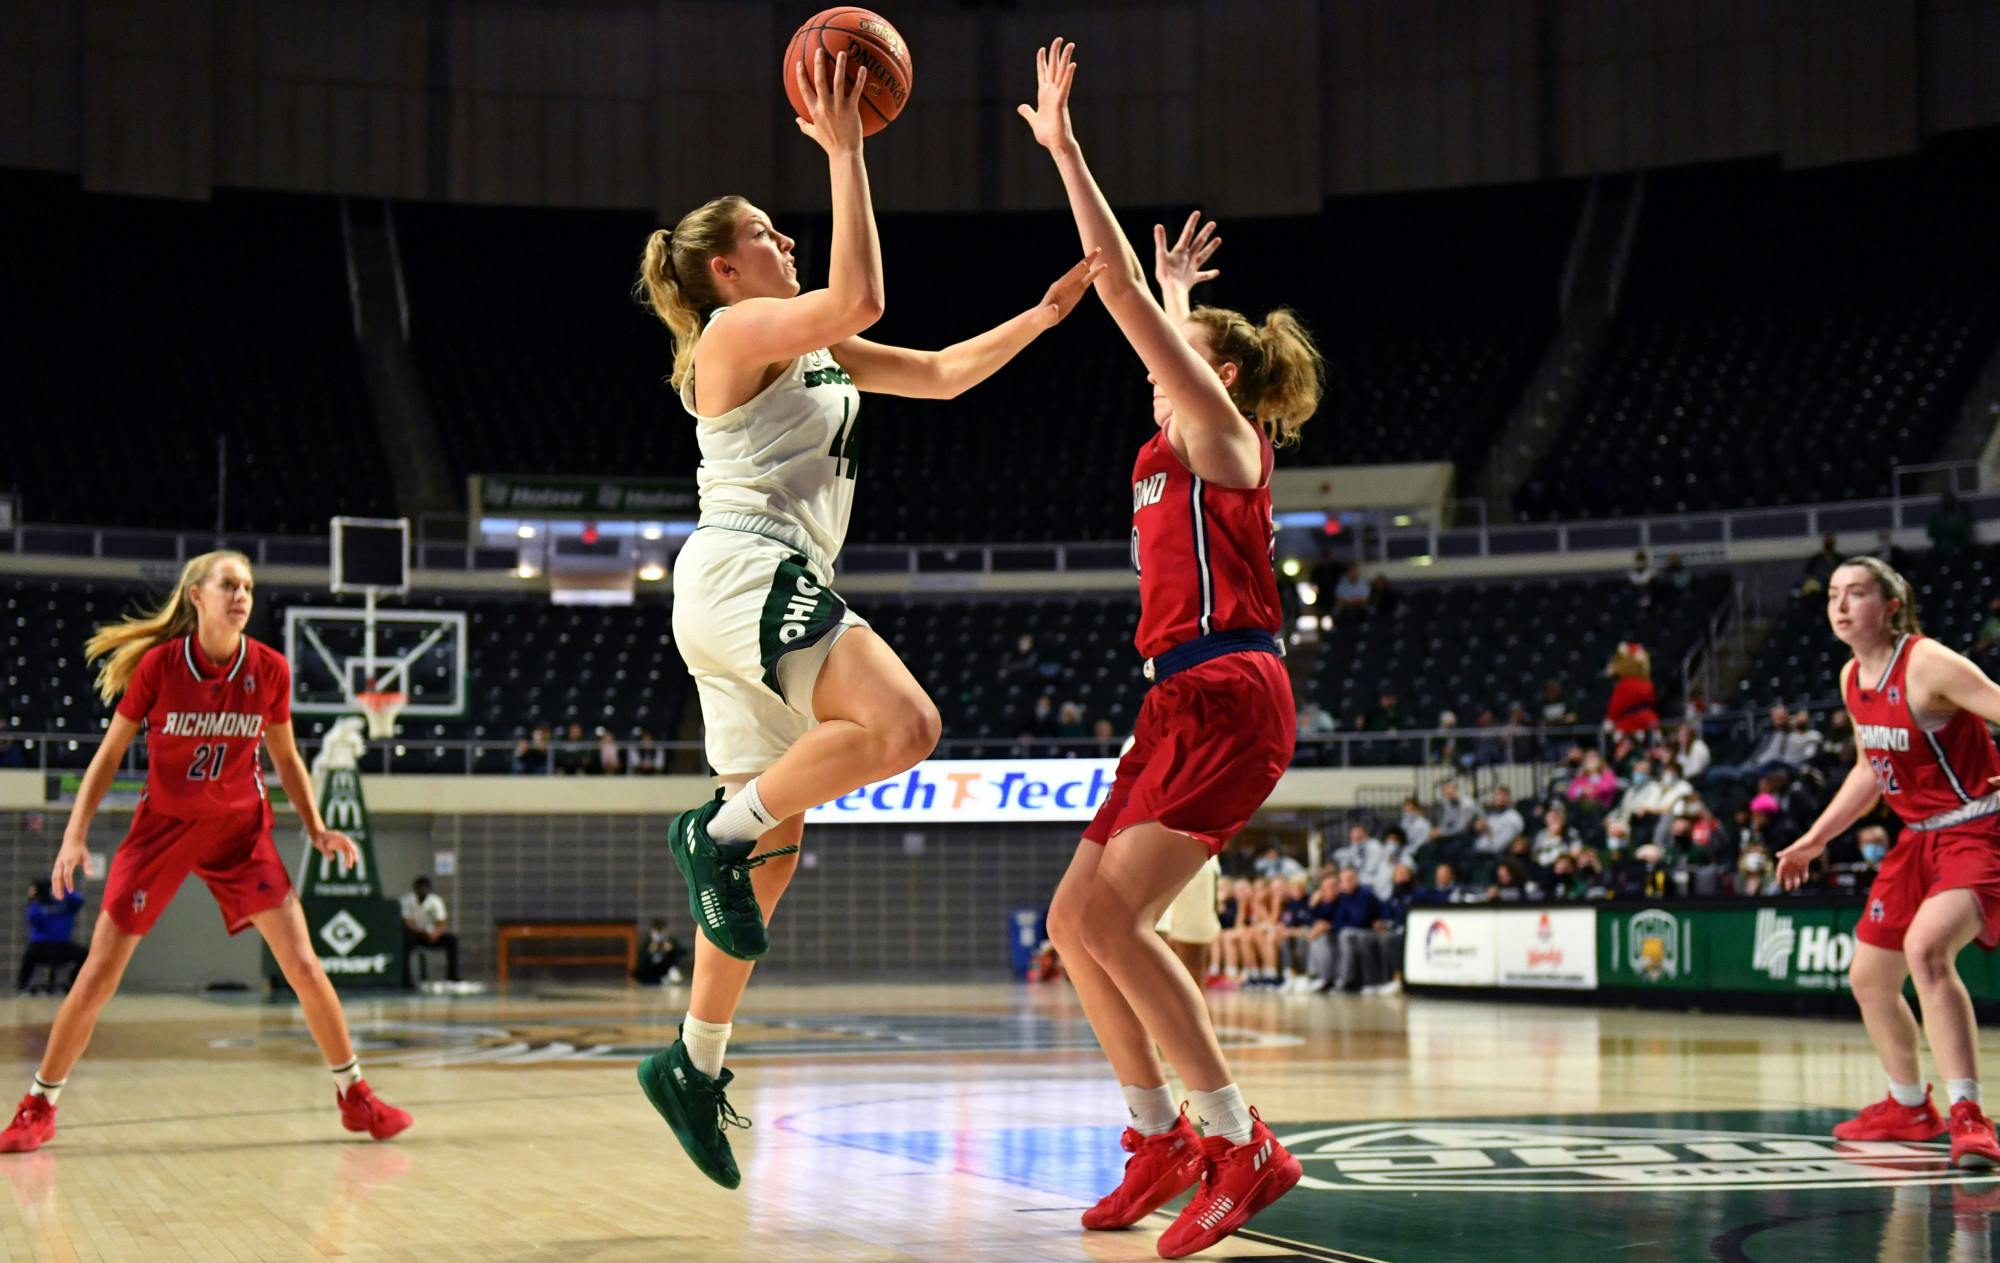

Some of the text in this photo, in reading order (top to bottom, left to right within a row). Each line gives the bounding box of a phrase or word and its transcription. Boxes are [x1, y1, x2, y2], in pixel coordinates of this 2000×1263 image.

[162, 711, 262, 738] RICHMOND
[187, 742, 227, 780] 21
[814, 769, 937, 812] ech
[988, 768, 1114, 810] Tech
